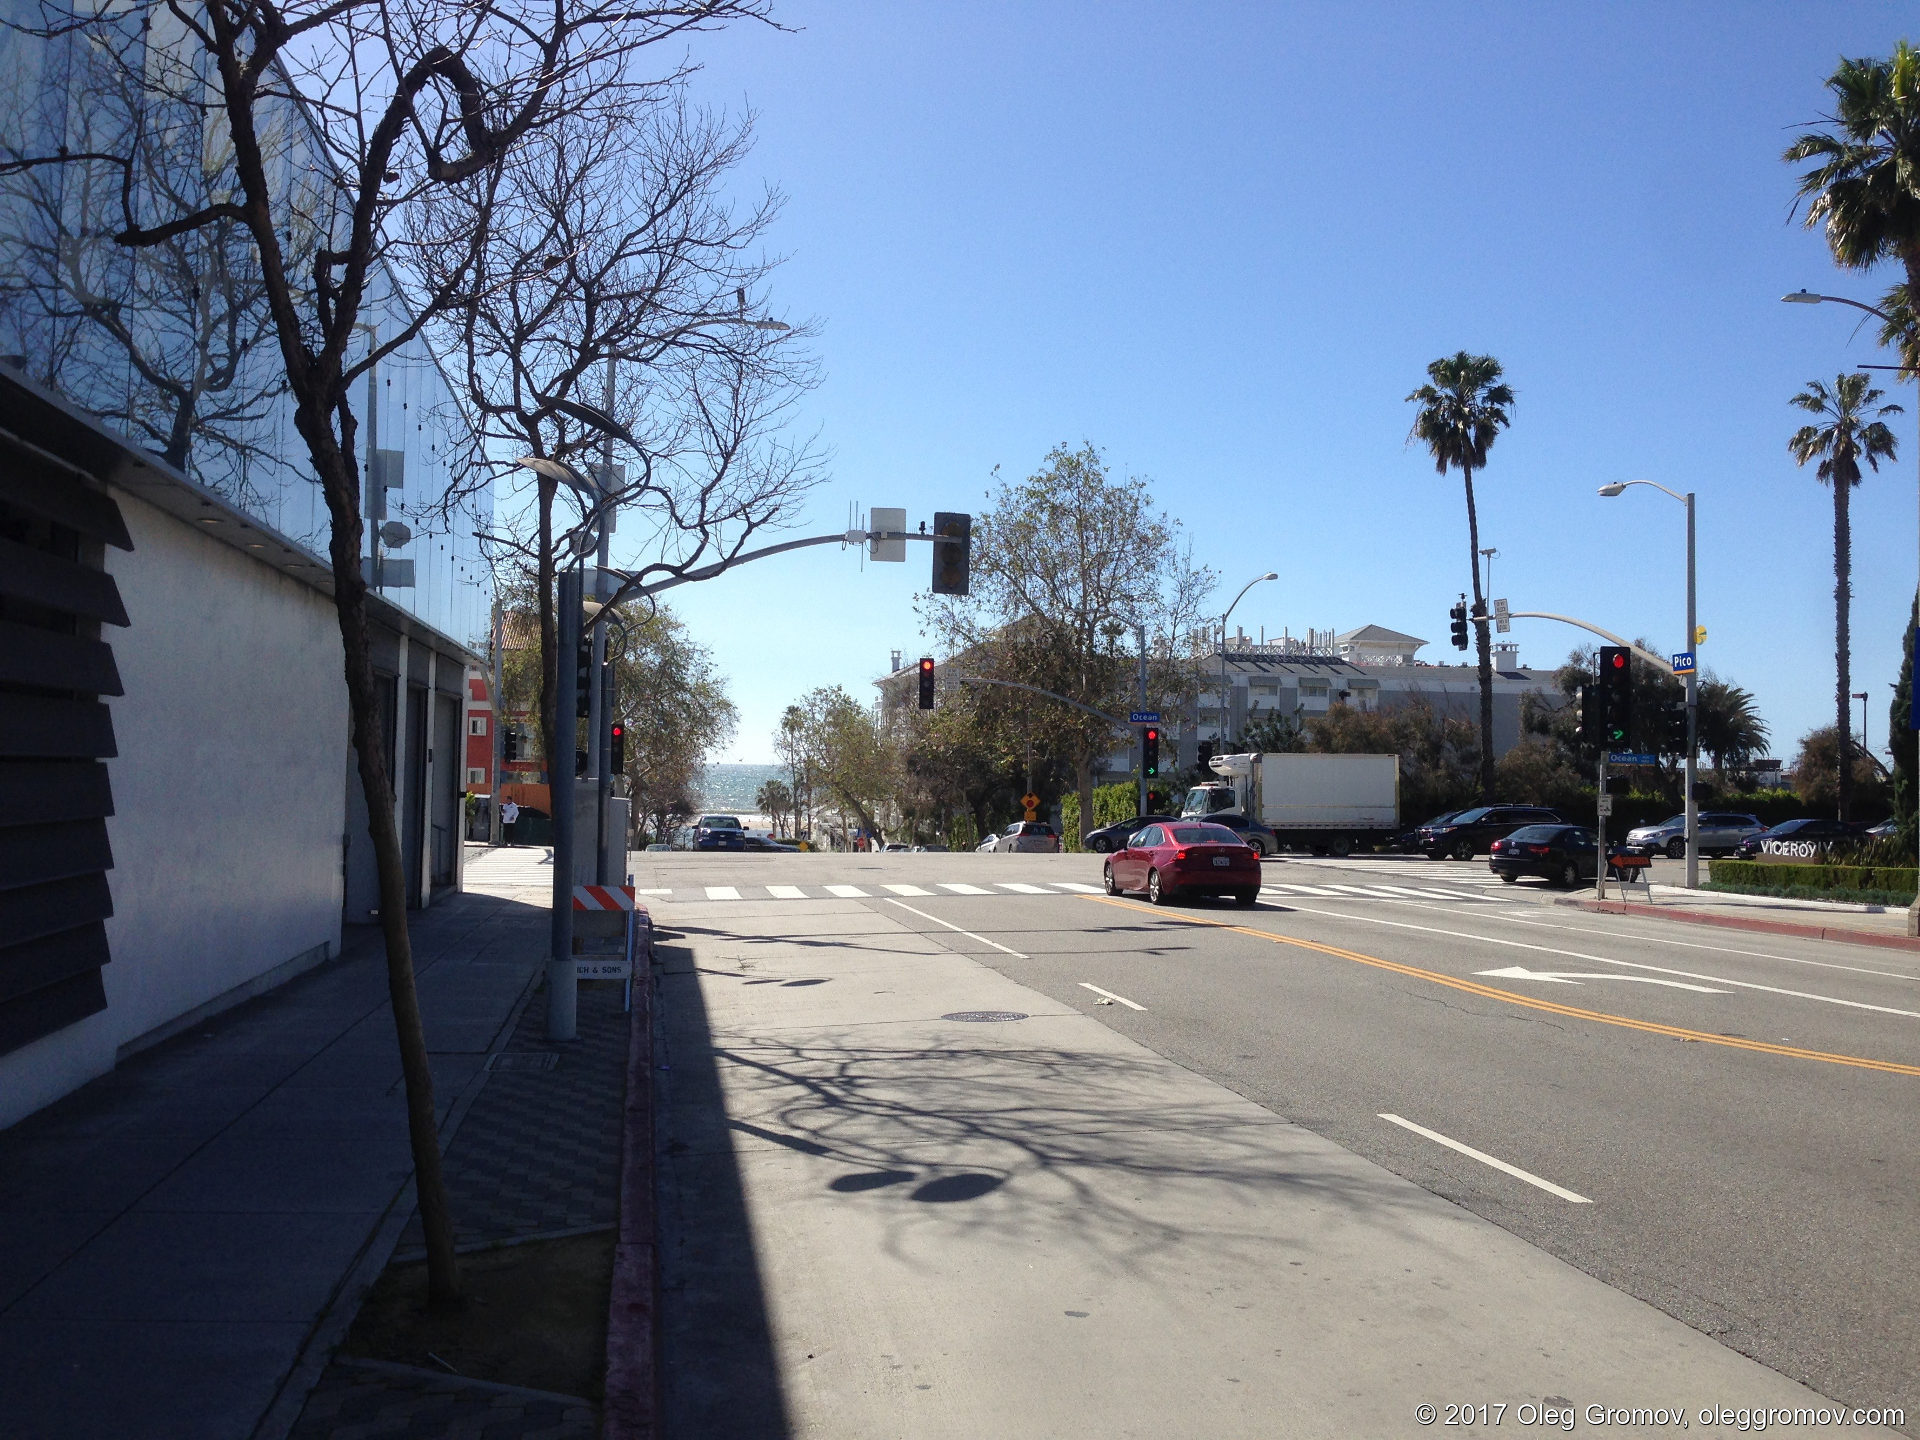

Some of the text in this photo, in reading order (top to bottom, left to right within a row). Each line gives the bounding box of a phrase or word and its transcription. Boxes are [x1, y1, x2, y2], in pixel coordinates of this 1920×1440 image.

[1674, 656, 1692, 667] Pico
[1132, 713, 1158, 721] Ocean
[1610, 754, 1638, 762] Ocean
[1760, 839, 1817, 858] VICEROY
[592, 966, 599, 974] &
[601, 966, 622, 974] SONS
